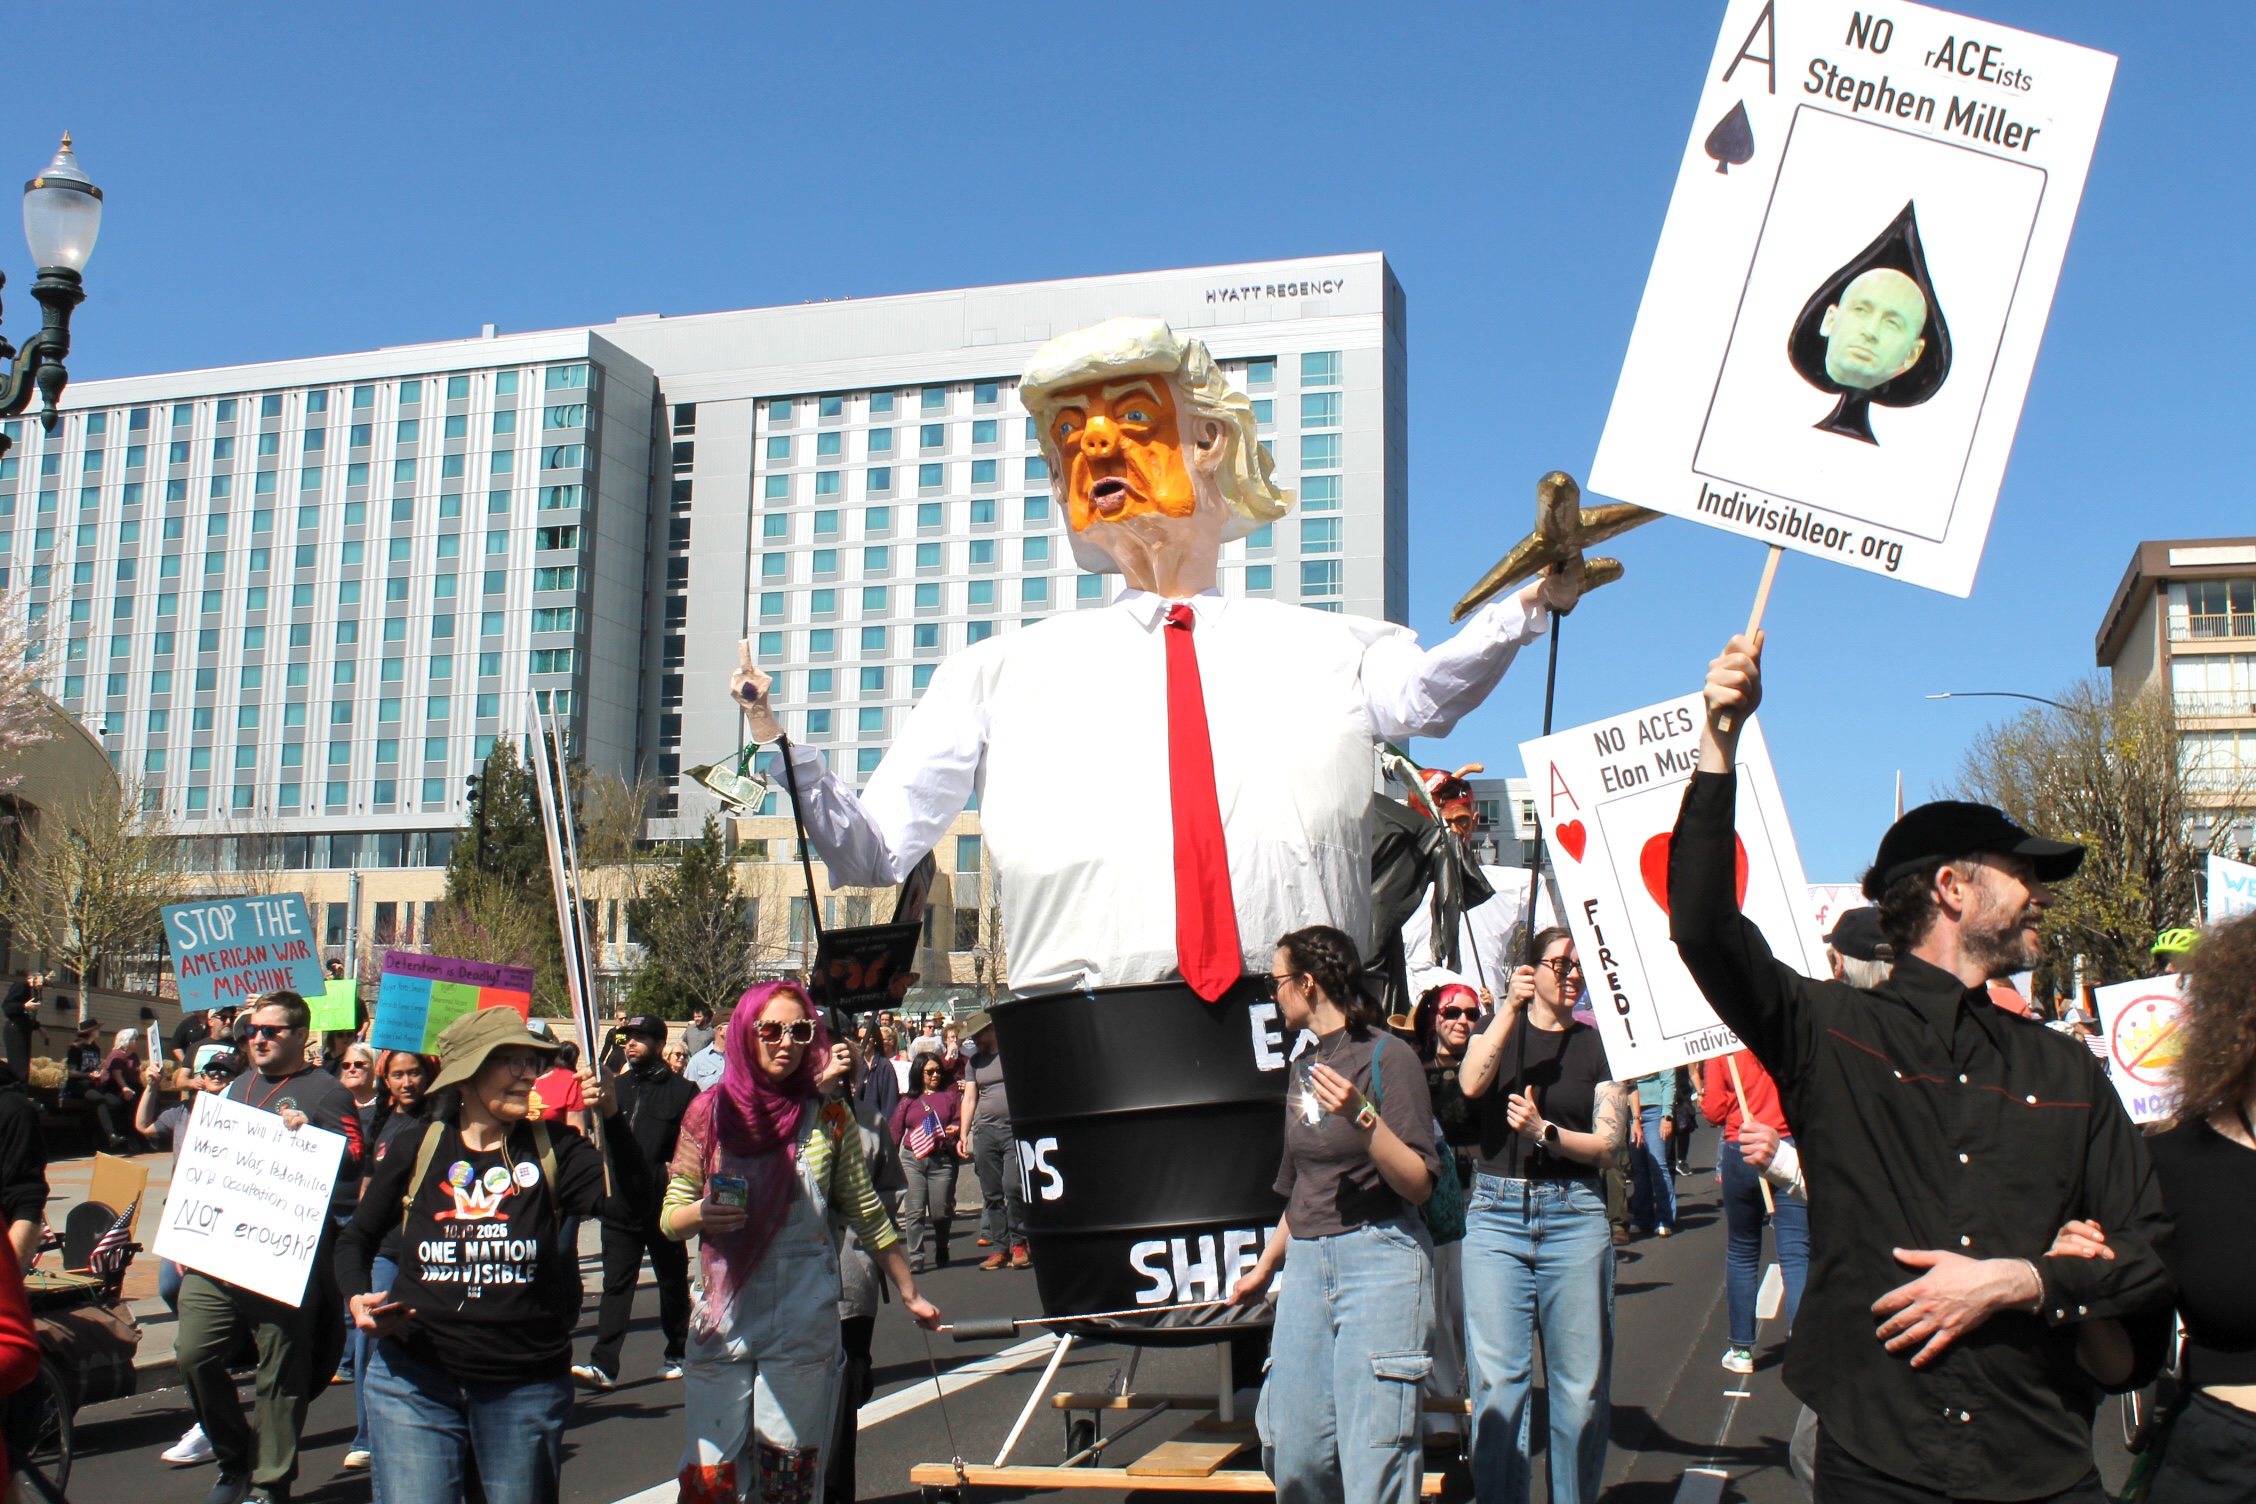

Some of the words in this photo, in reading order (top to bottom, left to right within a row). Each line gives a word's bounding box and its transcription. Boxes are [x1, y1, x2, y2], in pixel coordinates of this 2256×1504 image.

[1722, 0, 1776, 95] A
[1845, 11, 1894, 54] NO
[1924, 35, 2033, 92] rACEists
[1803, 58, 1935, 125] Stephen
[1943, 96, 2041, 152] Miller
[1206, 285, 1261, 304] HYATT
[1266, 278, 1344, 299] REGENCY
[1593, 727, 1626, 757] NO
[1638, 707, 1693, 745] ACES
[1550, 760, 1580, 818] A
[1600, 765, 1650, 793] Elon
[1654, 748, 1700, 777] Mus
[174, 905, 237, 950] STOP
[245, 899, 302, 937] THE
[181, 945, 268, 978] AMERICAN
[271, 939, 312, 962] WAR
[213, 967, 297, 1000] MACHINE
[386, 955, 442, 975] Detention
[446, 967, 455, 977] is
[458, 967, 501, 987] Deadly!
[1583, 898, 1637, 1048] FIRED!
[1682, 1027, 1739, 1056] indivis
[200, 1096, 239, 1131] What
[272, 1124, 283, 1142] it
[290, 1130, 318, 1152] take
[186, 1167, 217, 1184] and
[294, 1204, 320, 1222] are
[715, 1197, 739, 1206] JUICE
[174, 1199, 223, 1232] NOT
[234, 1223, 316, 1266] enough?
[418, 1240, 457, 1263] ONE
[465, 1239, 537, 1262] NATION
[420, 1263, 538, 1284] INDIVISIBLE
